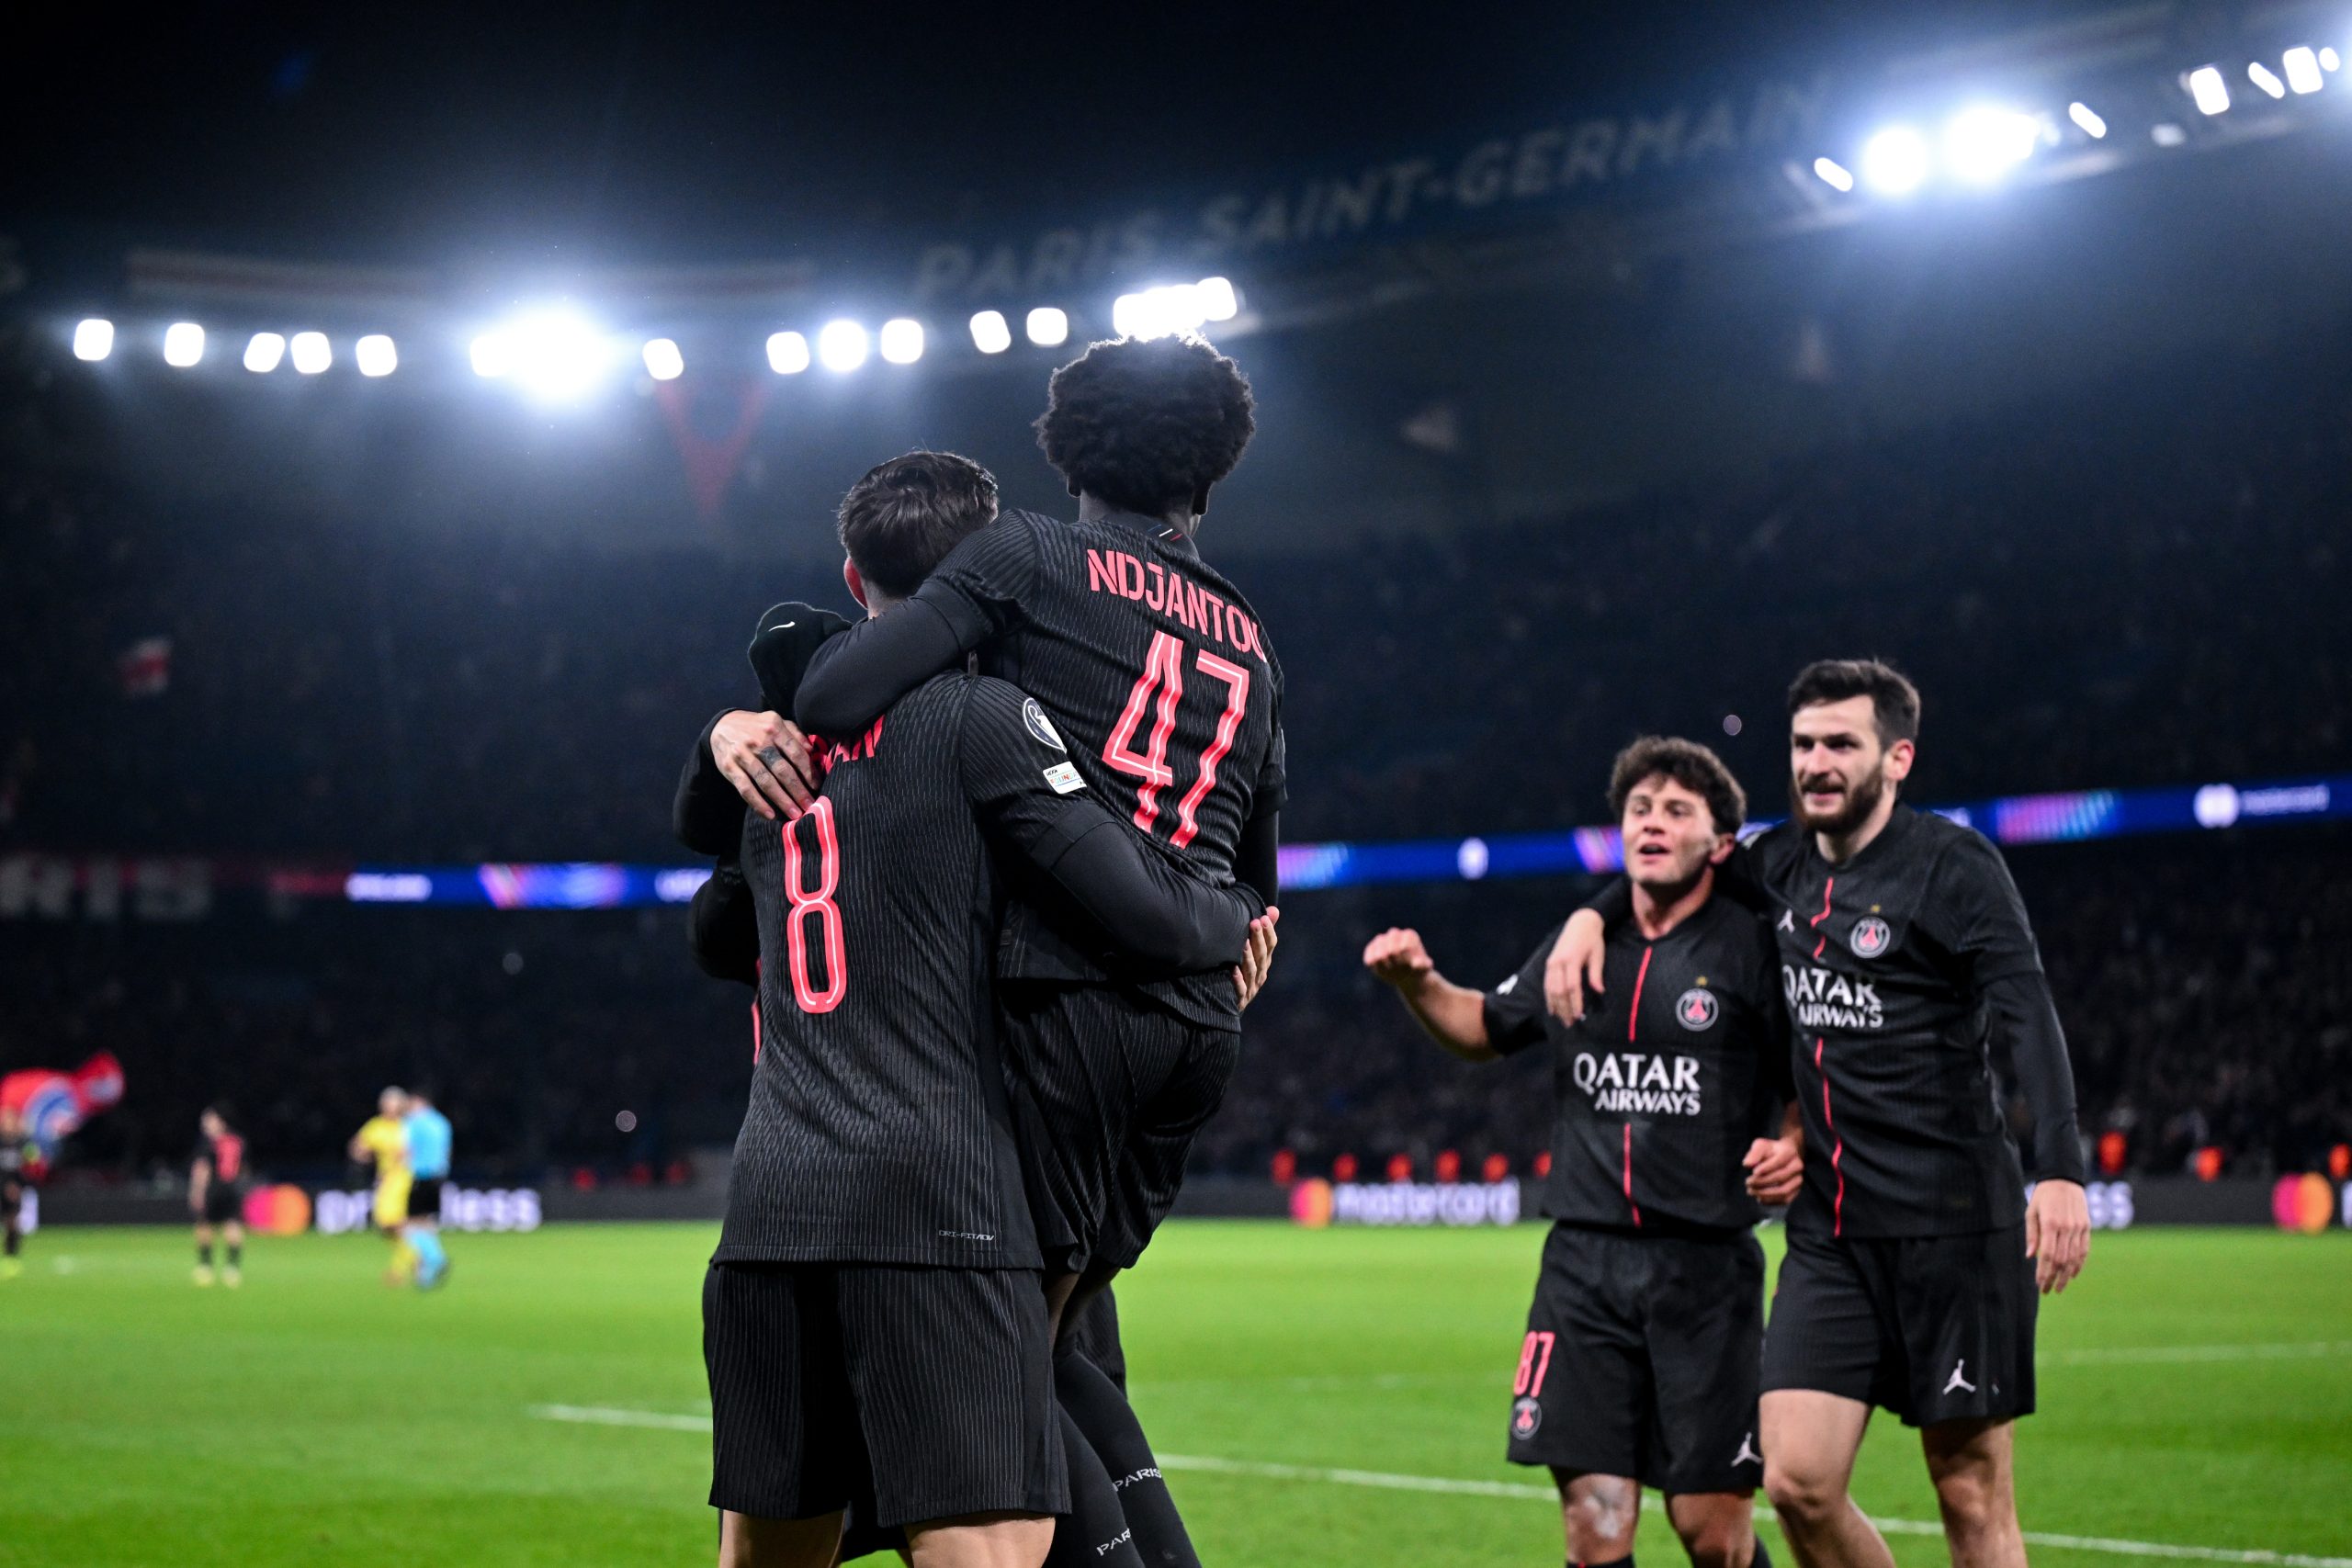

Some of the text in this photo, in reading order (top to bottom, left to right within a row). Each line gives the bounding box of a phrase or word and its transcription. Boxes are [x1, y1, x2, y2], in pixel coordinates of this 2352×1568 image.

[1193, 75, 1832, 250] SAINT-GERMAIN
[1102, 630, 1250, 849] 47
[782, 795, 846, 1013] 8
[1782, 964, 1882, 1009] QATAR
[1574, 1052, 1701, 1095] QATAR
[1594, 1089, 1701, 1116] AIRWAYS
[1335, 1176, 1521, 1226] mastercard
[1513, 1330, 1555, 1398] 87
[1112, 1468, 1162, 1493] PARIS
[1096, 1528, 1131, 1556] PAR
